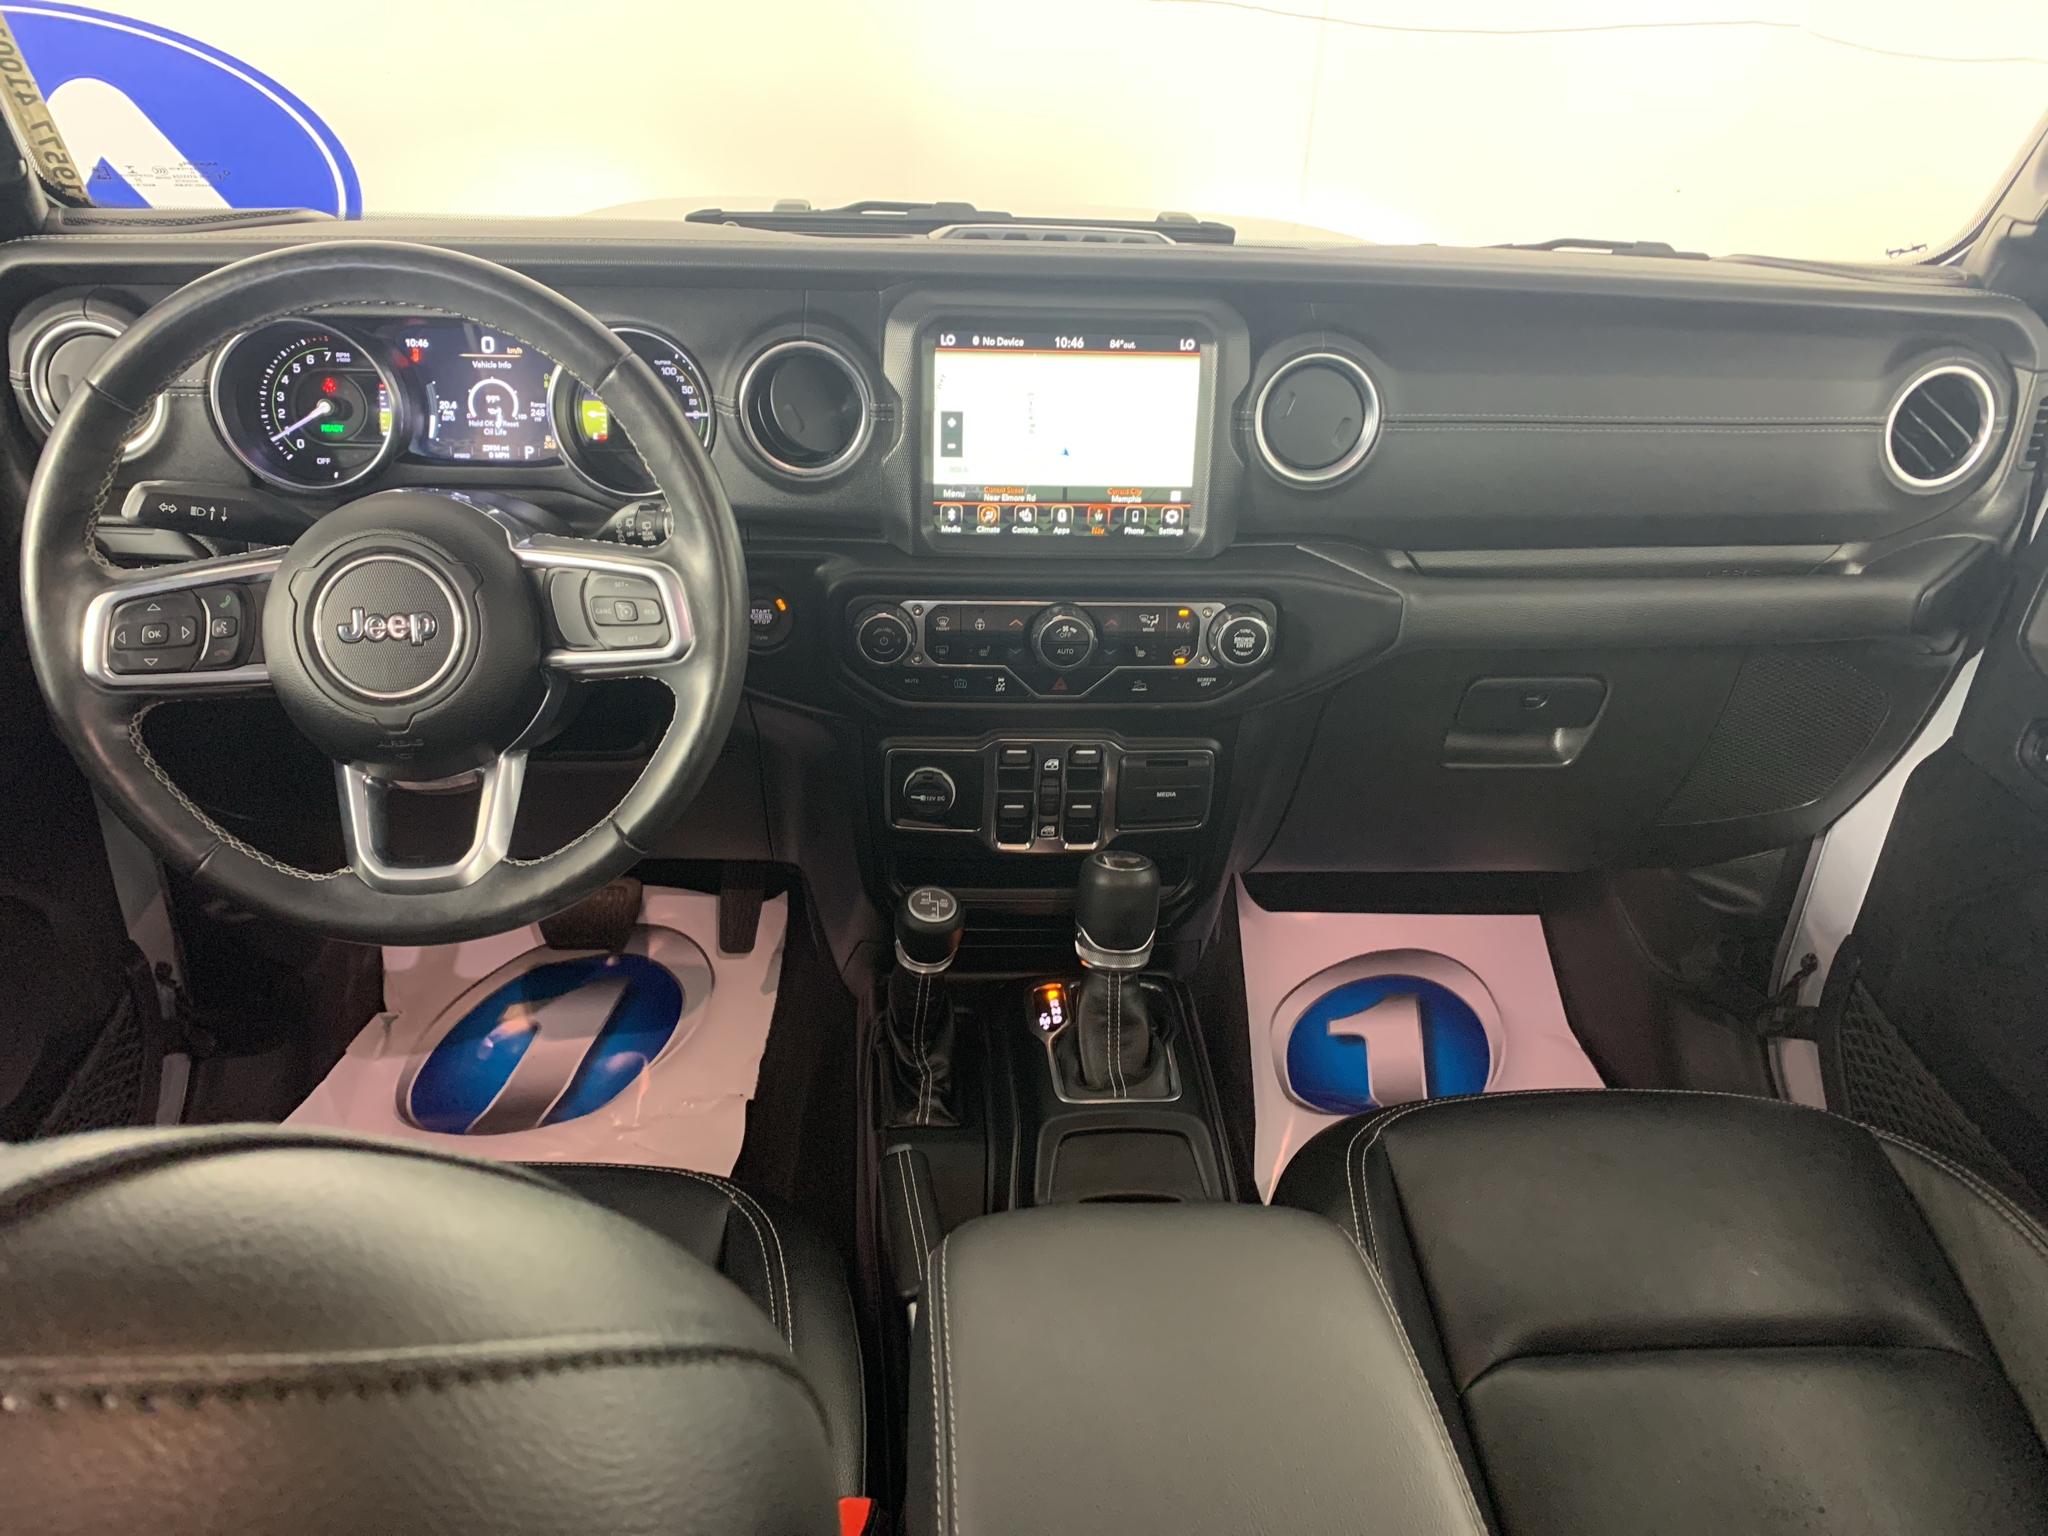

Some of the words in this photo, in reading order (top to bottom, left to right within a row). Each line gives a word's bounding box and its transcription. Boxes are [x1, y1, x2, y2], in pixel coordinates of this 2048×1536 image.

[405, 338, 429, 348] 10:46
[481, 336, 494, 353] 0
[941, 334, 956, 346] LO
[983, 336, 995, 346] No
[997, 336, 1024, 346] Device
[1054, 336, 1084, 349] 10:46
[1180, 338, 1195, 350] LO
[306, 355, 314, 364] 6
[324, 352, 331, 361] 7
[292, 364, 300, 374] 5
[499, 361, 512, 369] Info
[661, 367, 677, 376] 100
[281, 375, 289, 385] 4
[682, 386, 693, 394] 50
[276, 392, 285, 401] 3
[439, 400, 457, 410] 20.4
[277, 408, 286, 418] 2
[530, 409, 545, 417] 248
[321, 424, 344, 432] READY
[484, 428, 494, 436] Oil
[495, 428, 507, 436] Life
[1030, 424, 1036, 434] Rd
[296, 439, 305, 449] 0
[524, 446, 534, 460] P
[943, 489, 965, 498] Menu
[1002, 494, 1025, 502] Elmore
[1026, 494, 1036, 502] Rd
[1111, 495, 1142, 503] Memphis
[941, 525, 961, 533] Media
[976, 526, 1000, 534] Climate
[1012, 526, 1038, 534] Controls
[1053, 527, 1070, 535] Apps
[1091, 527, 1104, 535] Nav
[1124, 527, 1145, 535] Phone
[1159, 527, 1183, 536] Settings
[337, 607, 438, 647] Jeep
[1176, 621, 1190, 630] A/C
[148, 630, 161, 639] OK
[1326, 992, 1428, 1107] 1
